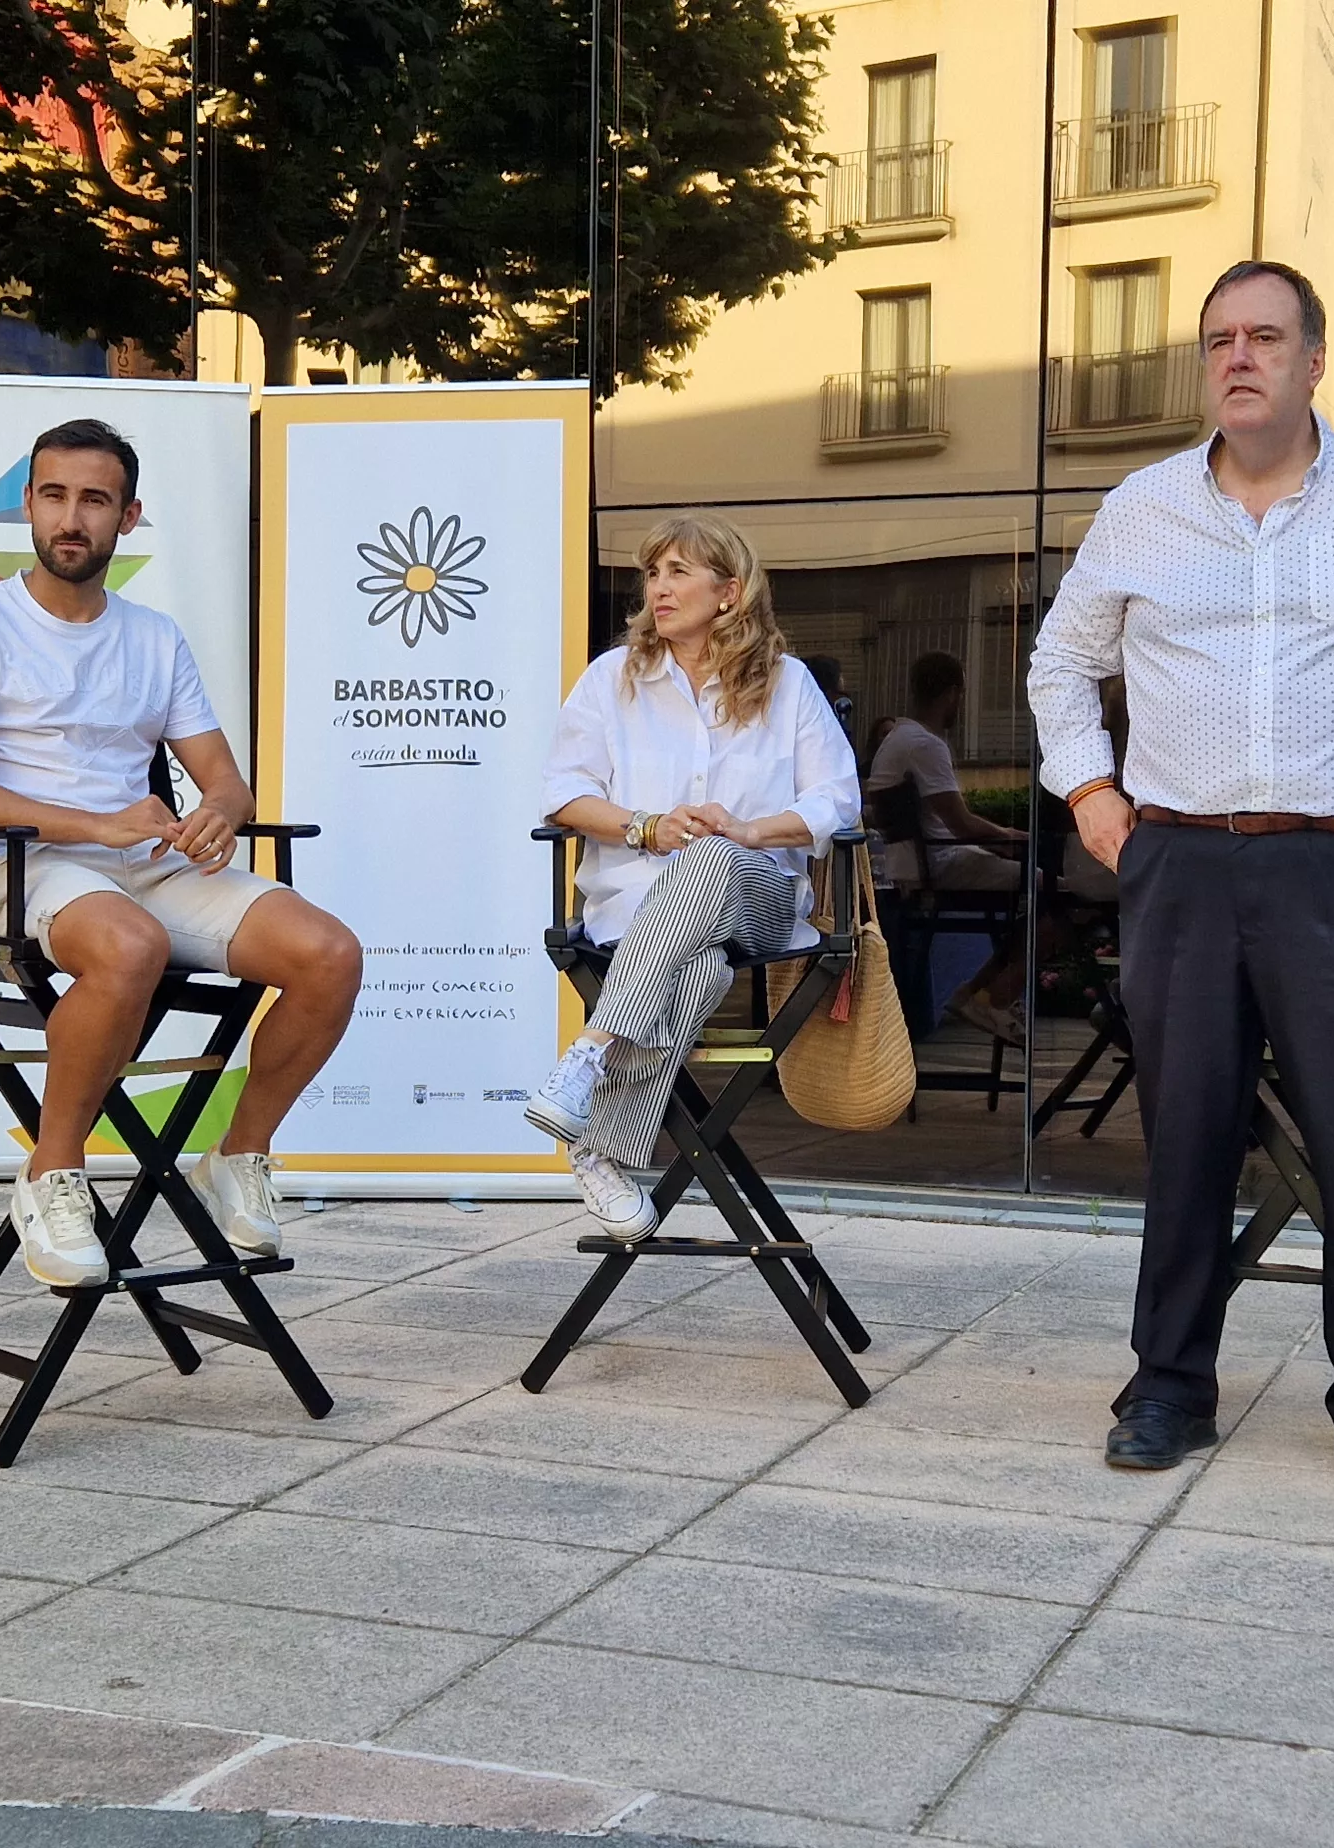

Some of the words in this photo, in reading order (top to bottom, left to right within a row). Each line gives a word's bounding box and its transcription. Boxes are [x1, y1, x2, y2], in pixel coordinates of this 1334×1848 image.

[334, 679, 494, 702] BARBASTRO
[495, 688, 510, 706] y
[333, 710, 350, 728] el
[352, 708, 507, 729] SOMONTANO
[351, 744, 396, 761] están
[400, 743, 422, 761] de
[427, 743, 478, 761] moda
[403, 943, 419, 956] de
[421, 943, 475, 956] acuerdo
[479, 946, 495, 956] en
[498, 943, 531, 959] algo:
[374, 980, 385, 991] el
[389, 981, 426, 994] mejor
[359, 1006, 387, 1018] vivir
